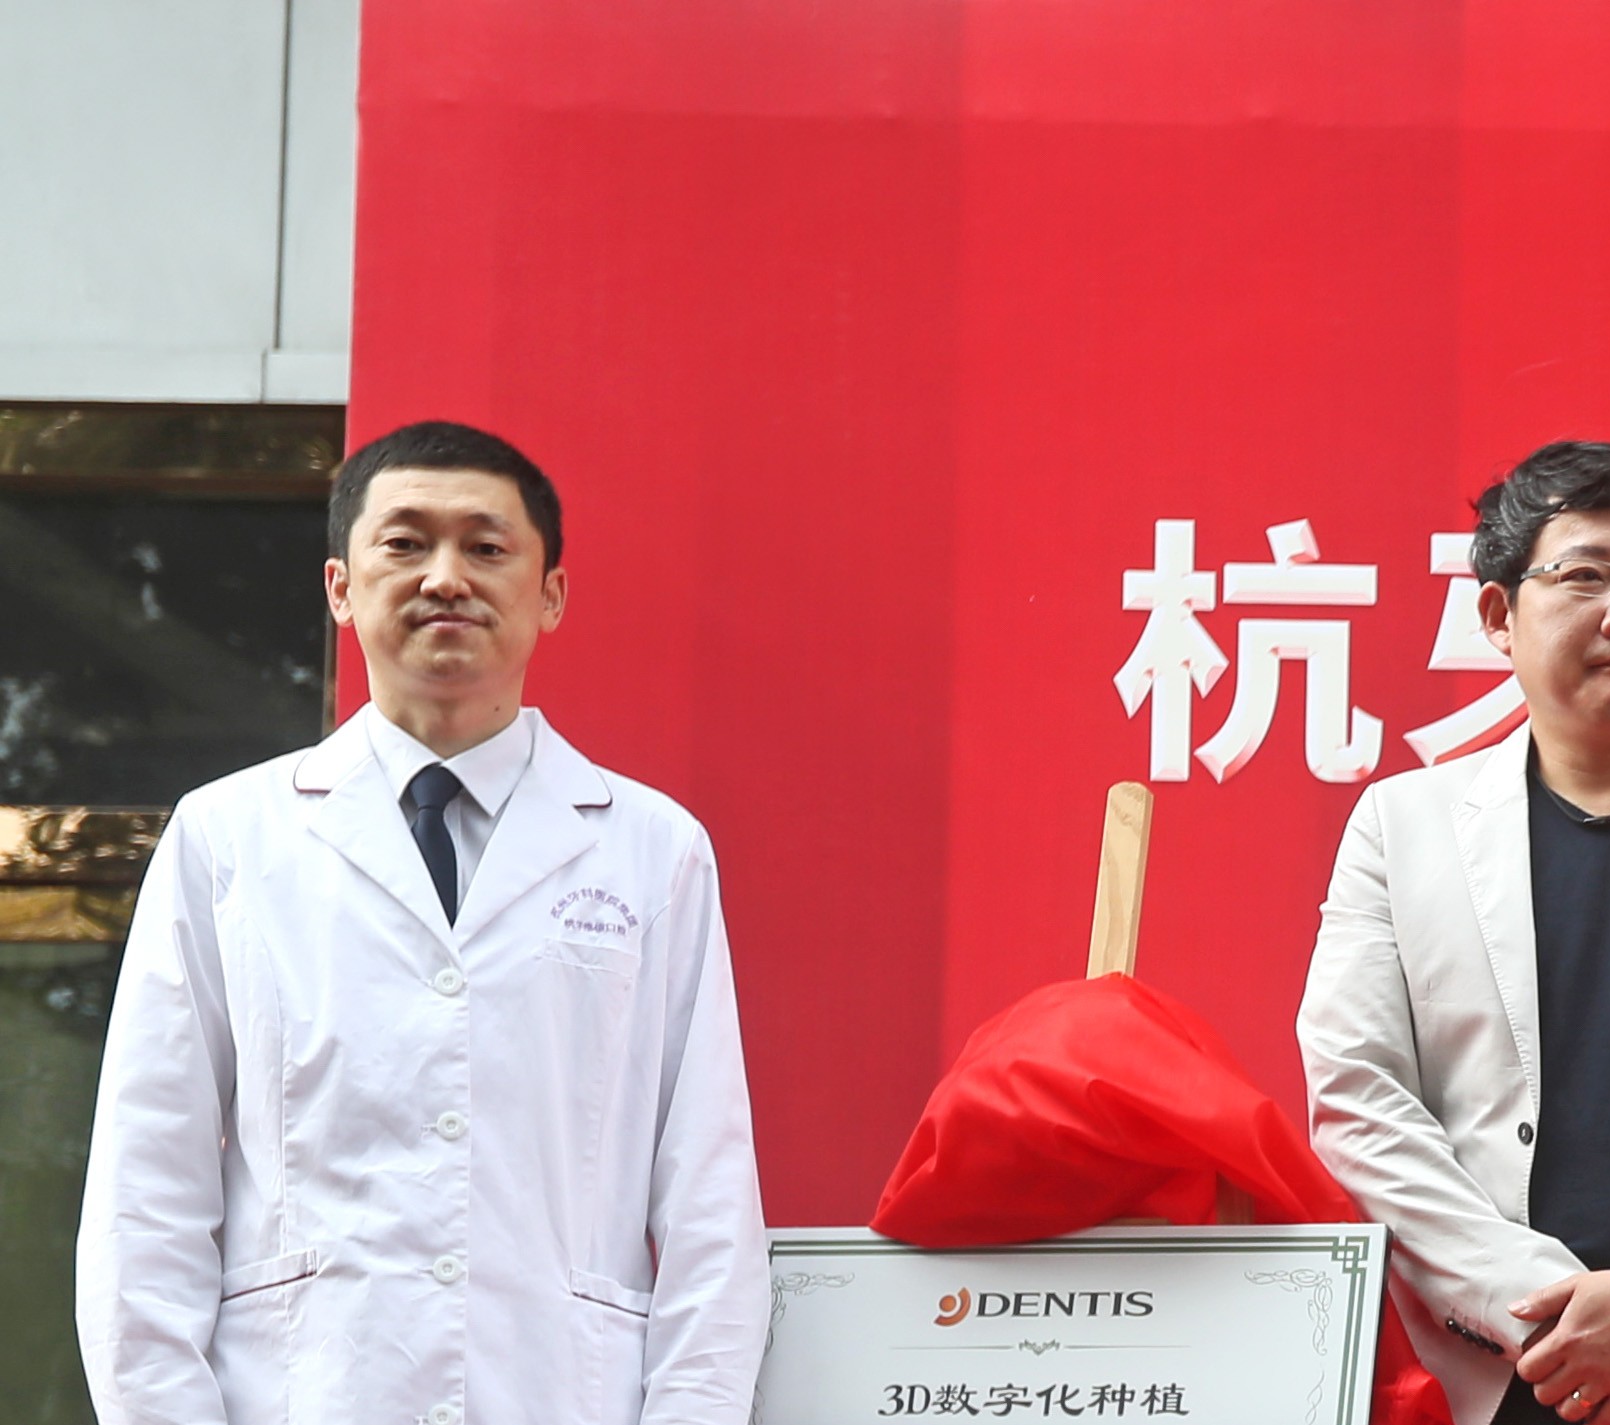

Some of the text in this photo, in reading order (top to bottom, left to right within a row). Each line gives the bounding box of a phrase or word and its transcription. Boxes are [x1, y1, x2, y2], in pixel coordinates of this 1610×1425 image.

[976, 1290, 1154, 1318] DENTIS
[878, 1382, 1190, 1418] 3D数字化种植
